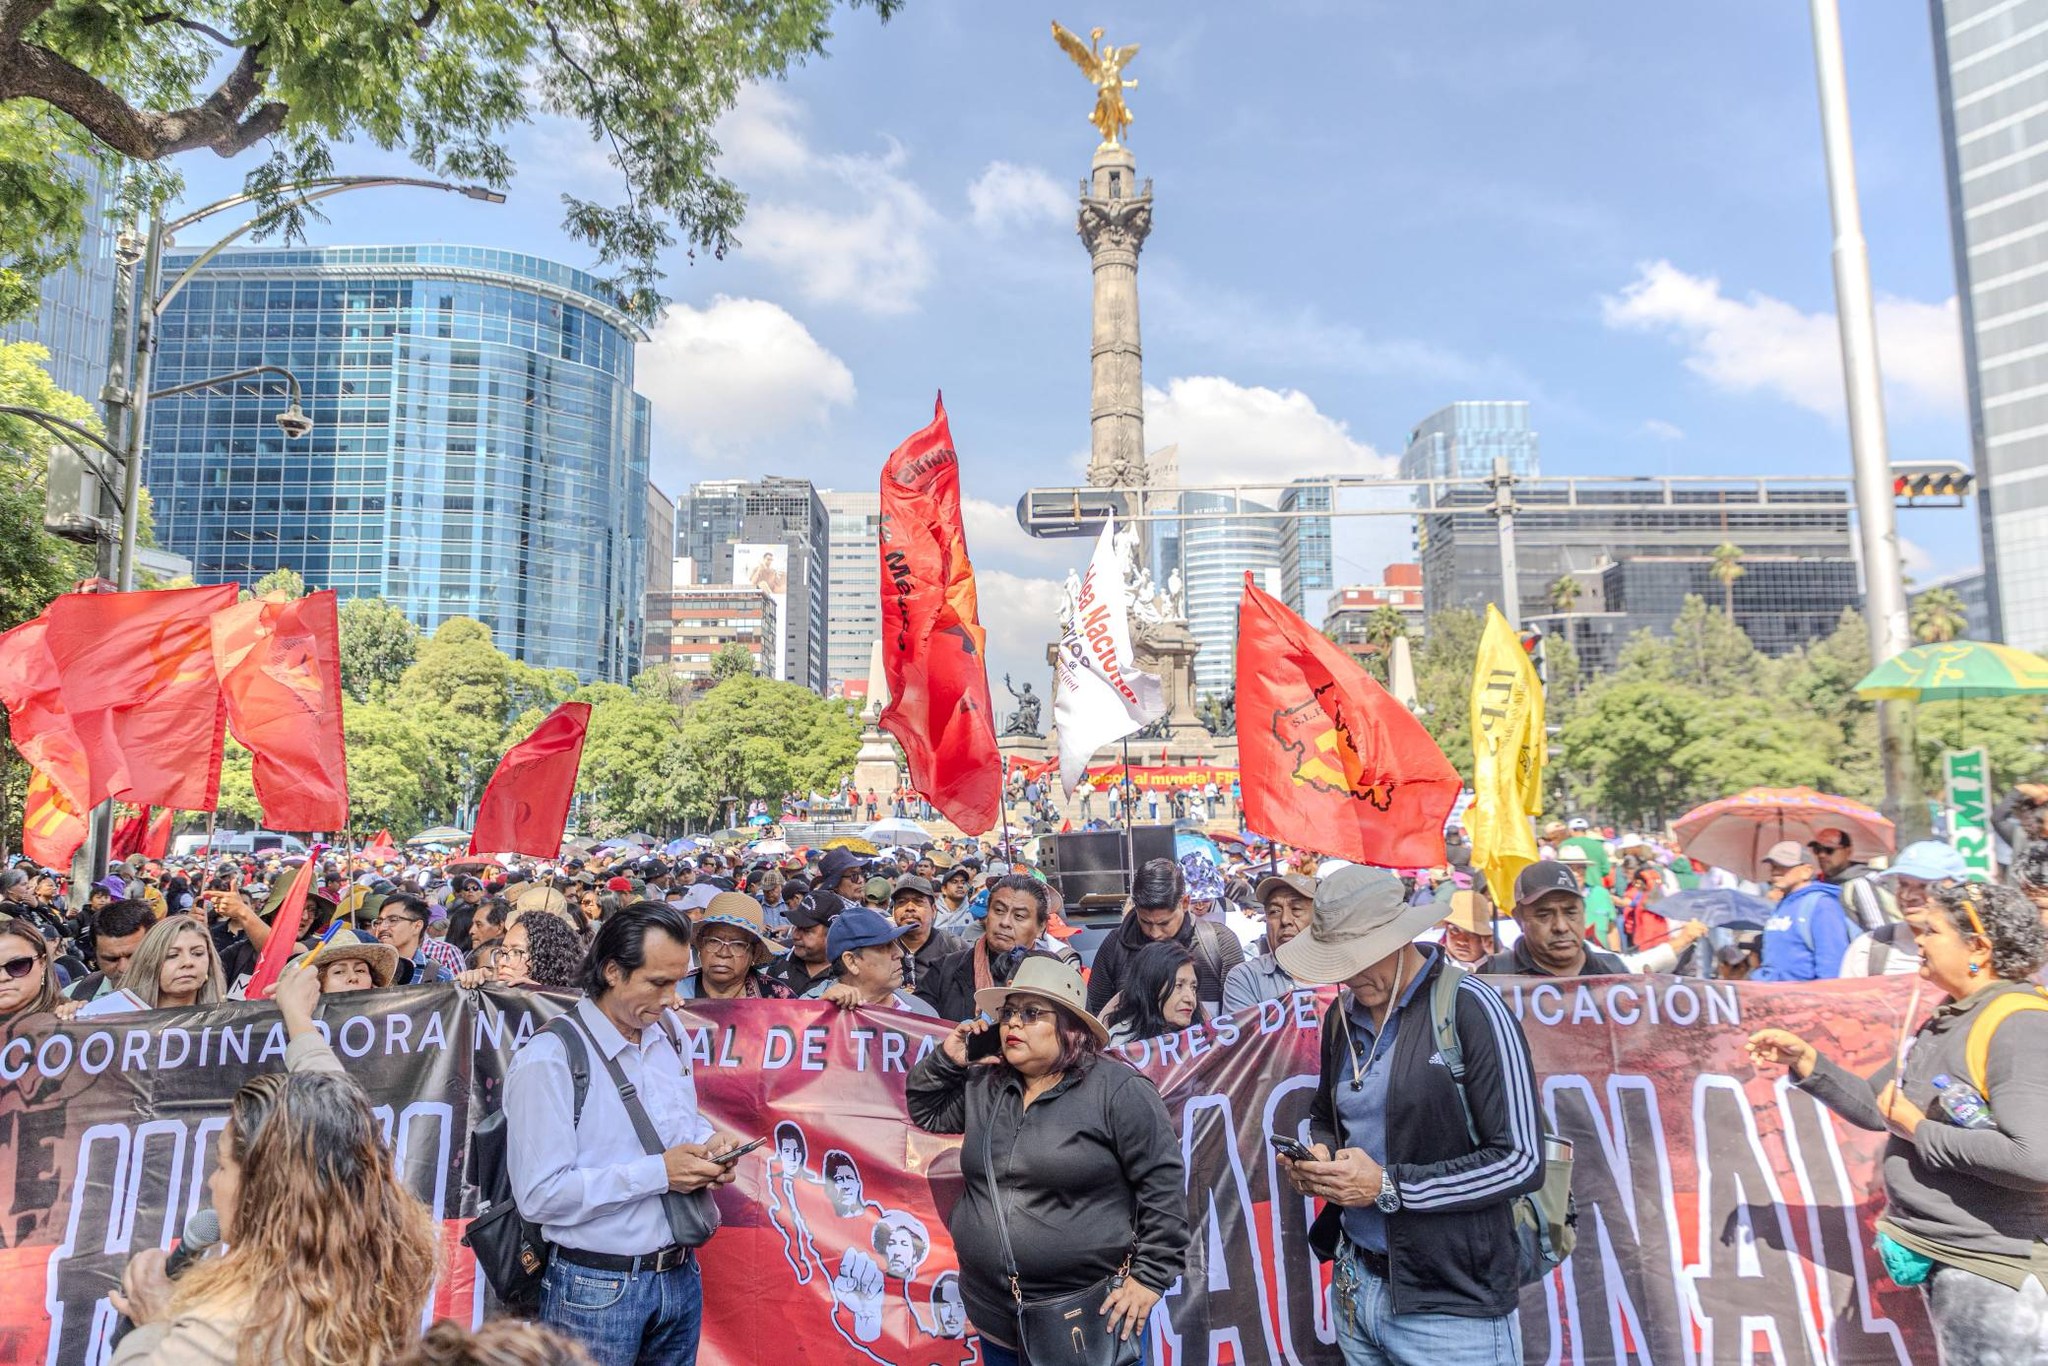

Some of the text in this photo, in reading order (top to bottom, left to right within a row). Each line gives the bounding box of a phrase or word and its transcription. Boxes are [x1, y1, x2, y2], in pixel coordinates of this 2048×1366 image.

[1134, 771, 1148, 784] al
[1151, 771, 1210, 785] mundial
[763, 1028, 826, 1071] DE
[1258, 990, 1318, 1036] DE
